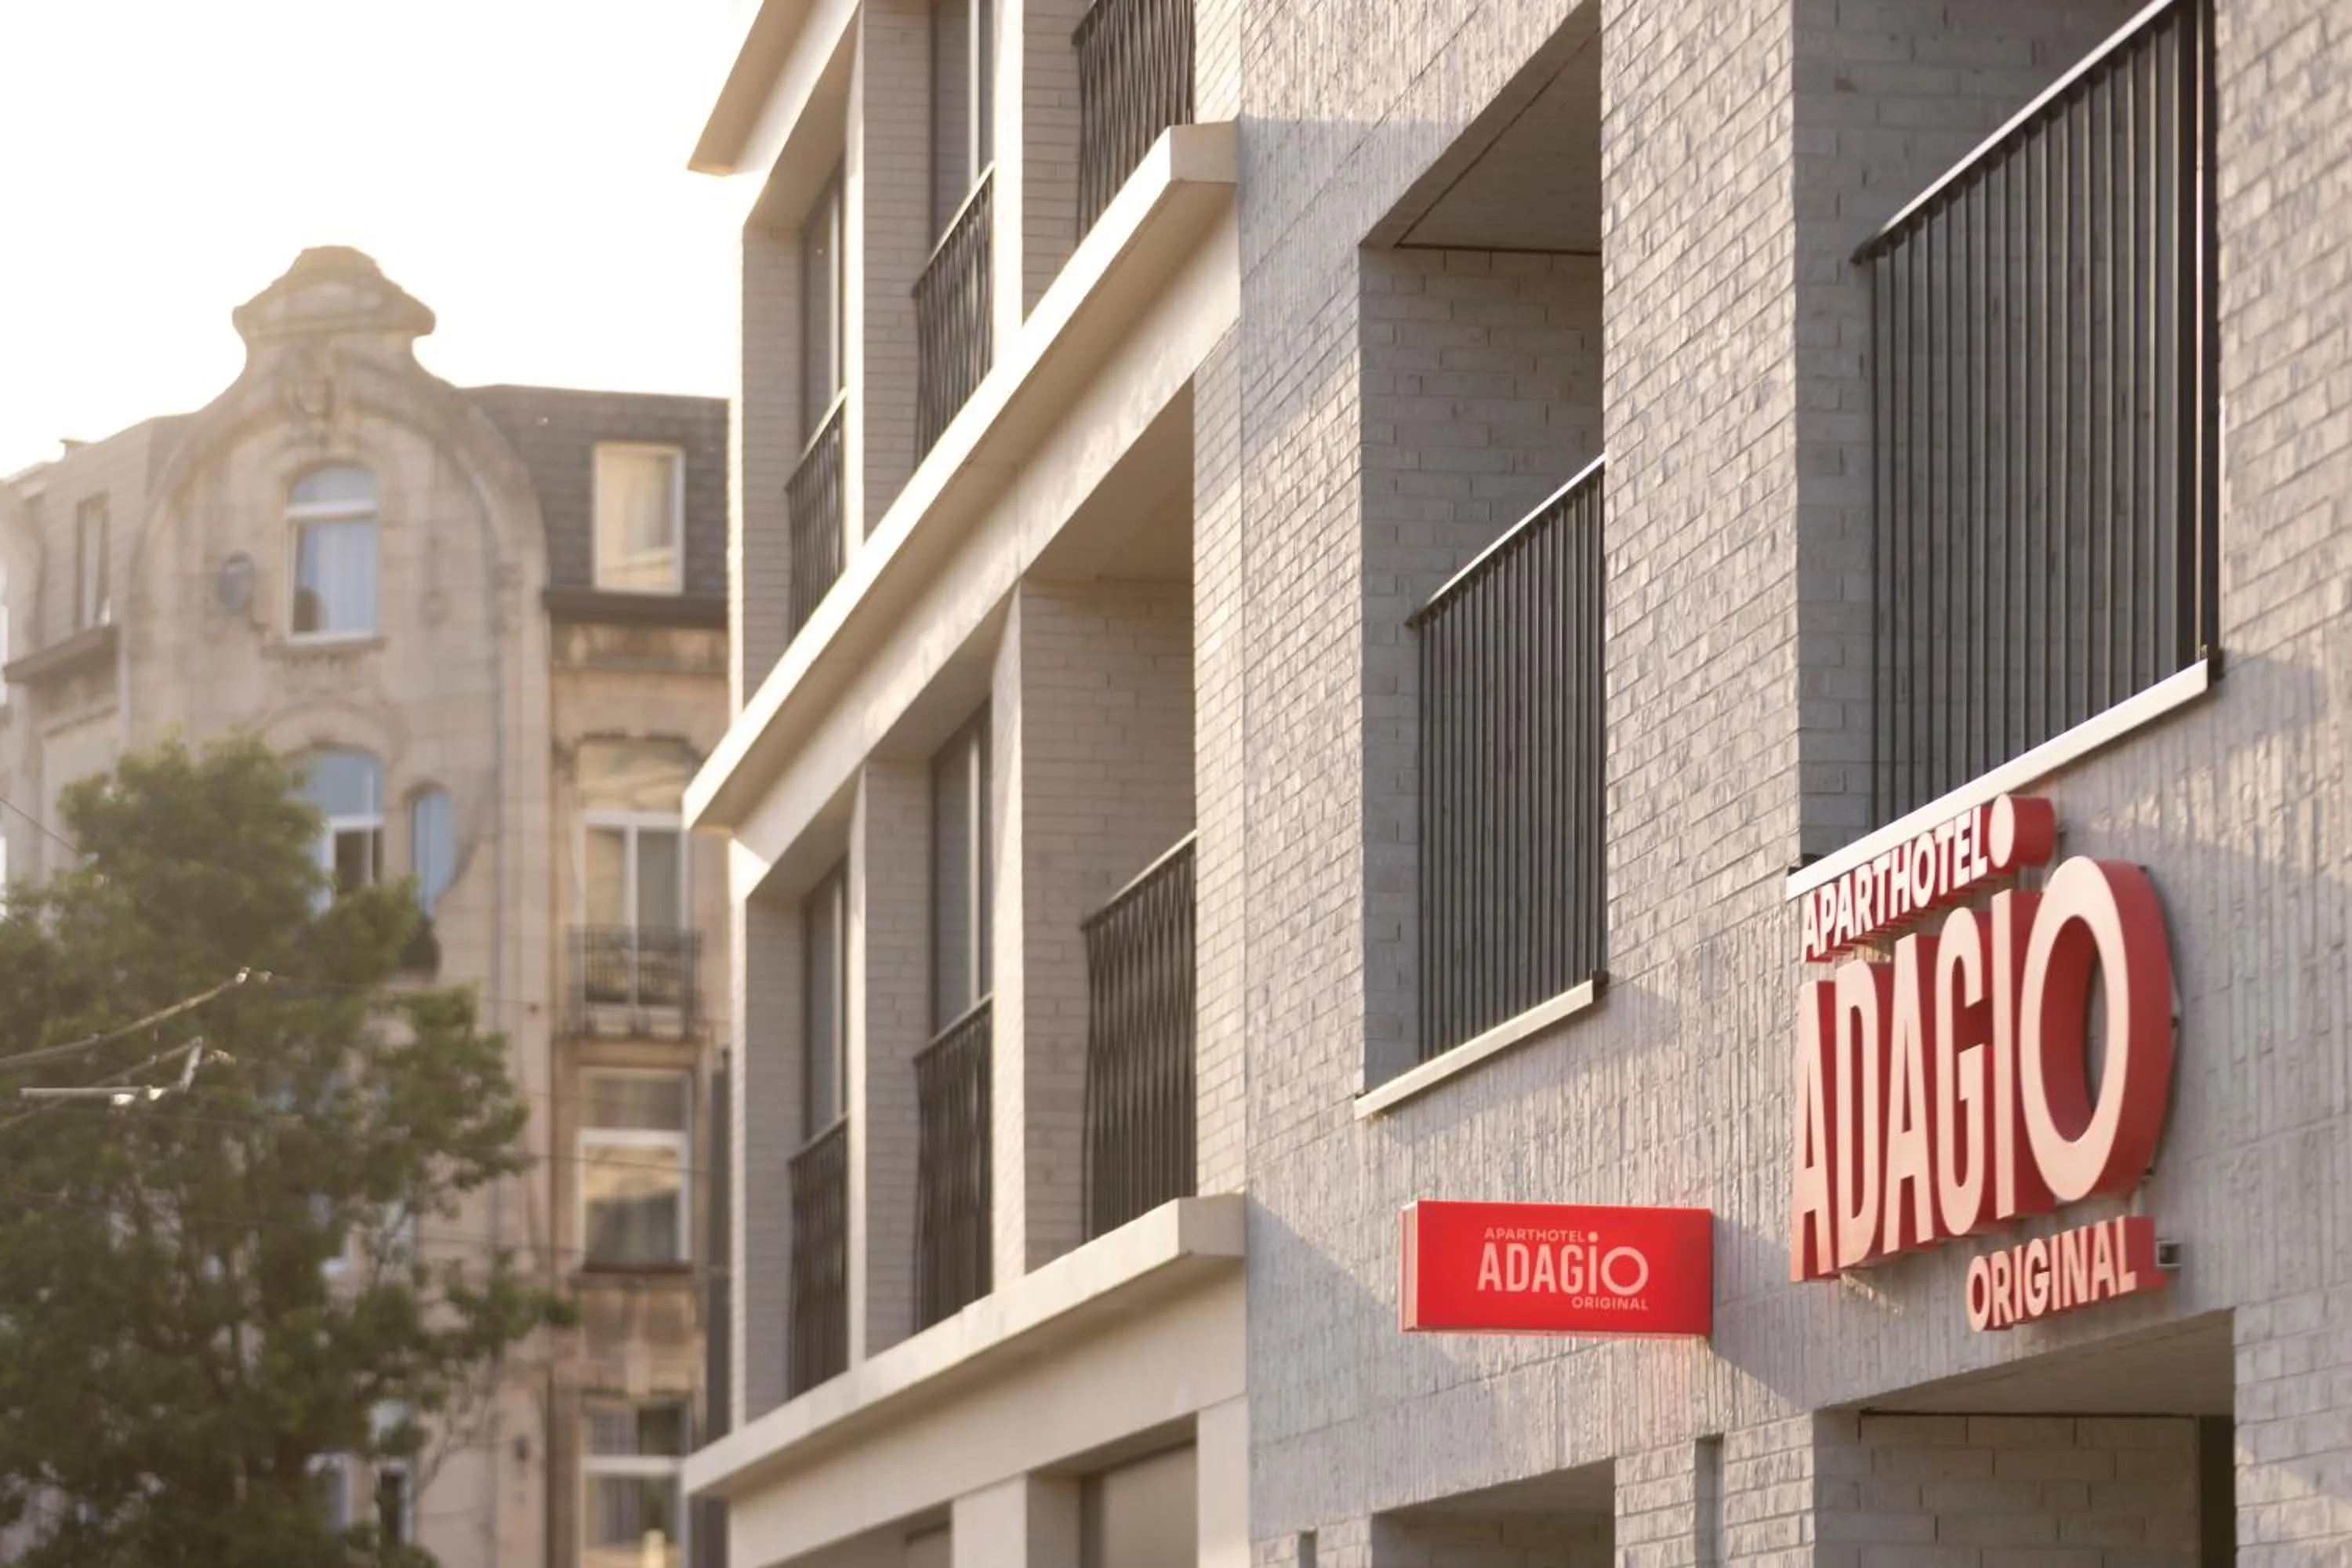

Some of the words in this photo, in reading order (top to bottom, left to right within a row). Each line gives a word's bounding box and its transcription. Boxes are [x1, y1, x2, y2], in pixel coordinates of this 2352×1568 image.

[1802, 804, 1989, 962] APARTHOTEL
[1485, 1228, 1584, 1243] APARTHOTEL
[1572, 1296, 1650, 1311] ORIGINAL
[1966, 1216, 2139, 1333] ORIGINAL
